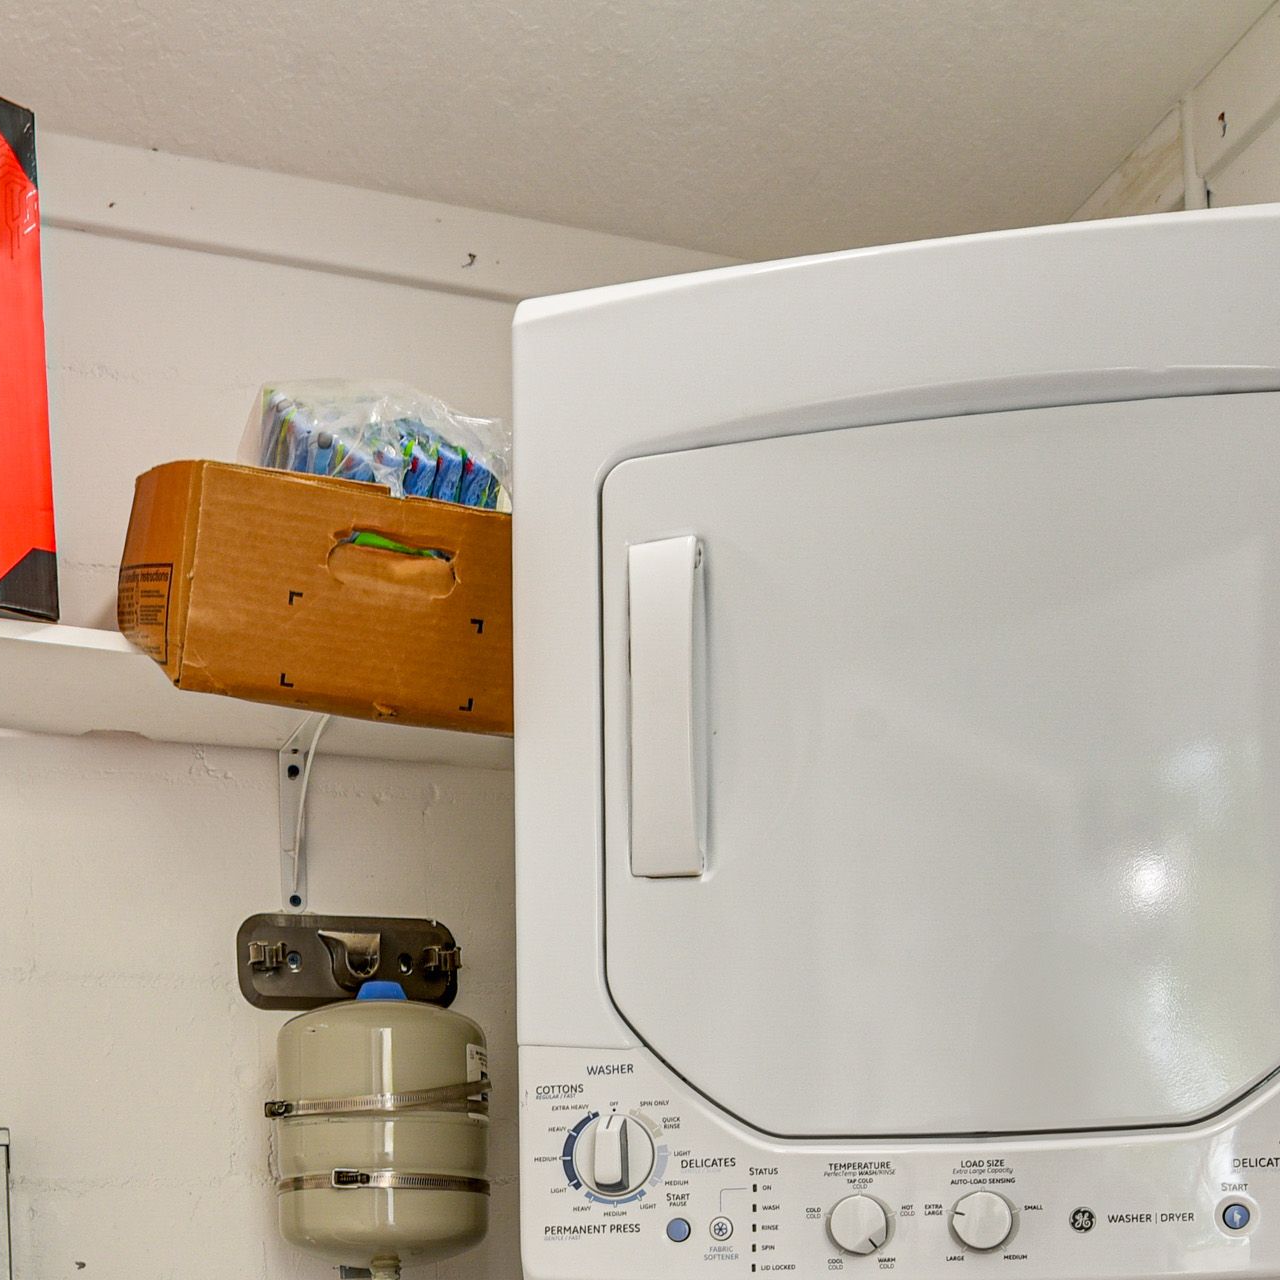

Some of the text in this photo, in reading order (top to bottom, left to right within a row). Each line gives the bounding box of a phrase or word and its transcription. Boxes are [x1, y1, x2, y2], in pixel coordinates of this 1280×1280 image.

[586, 1064, 634, 1076] WASHER
[536, 1084, 584, 1095] COTTONS
[680, 1158, 736, 1169] DELICATES
[829, 1161, 891, 1170] TEMPERATURE
[960, 1159, 1005, 1168] LOAD SIZE
[749, 1167, 779, 1176] STATUS
[1221, 1183, 1248, 1191] START
[666, 1193, 690, 1201] START
[1108, 1211, 1195, 1224] WASHER DRYER
[544, 1224, 641, 1235] PERMANENT PRESS
